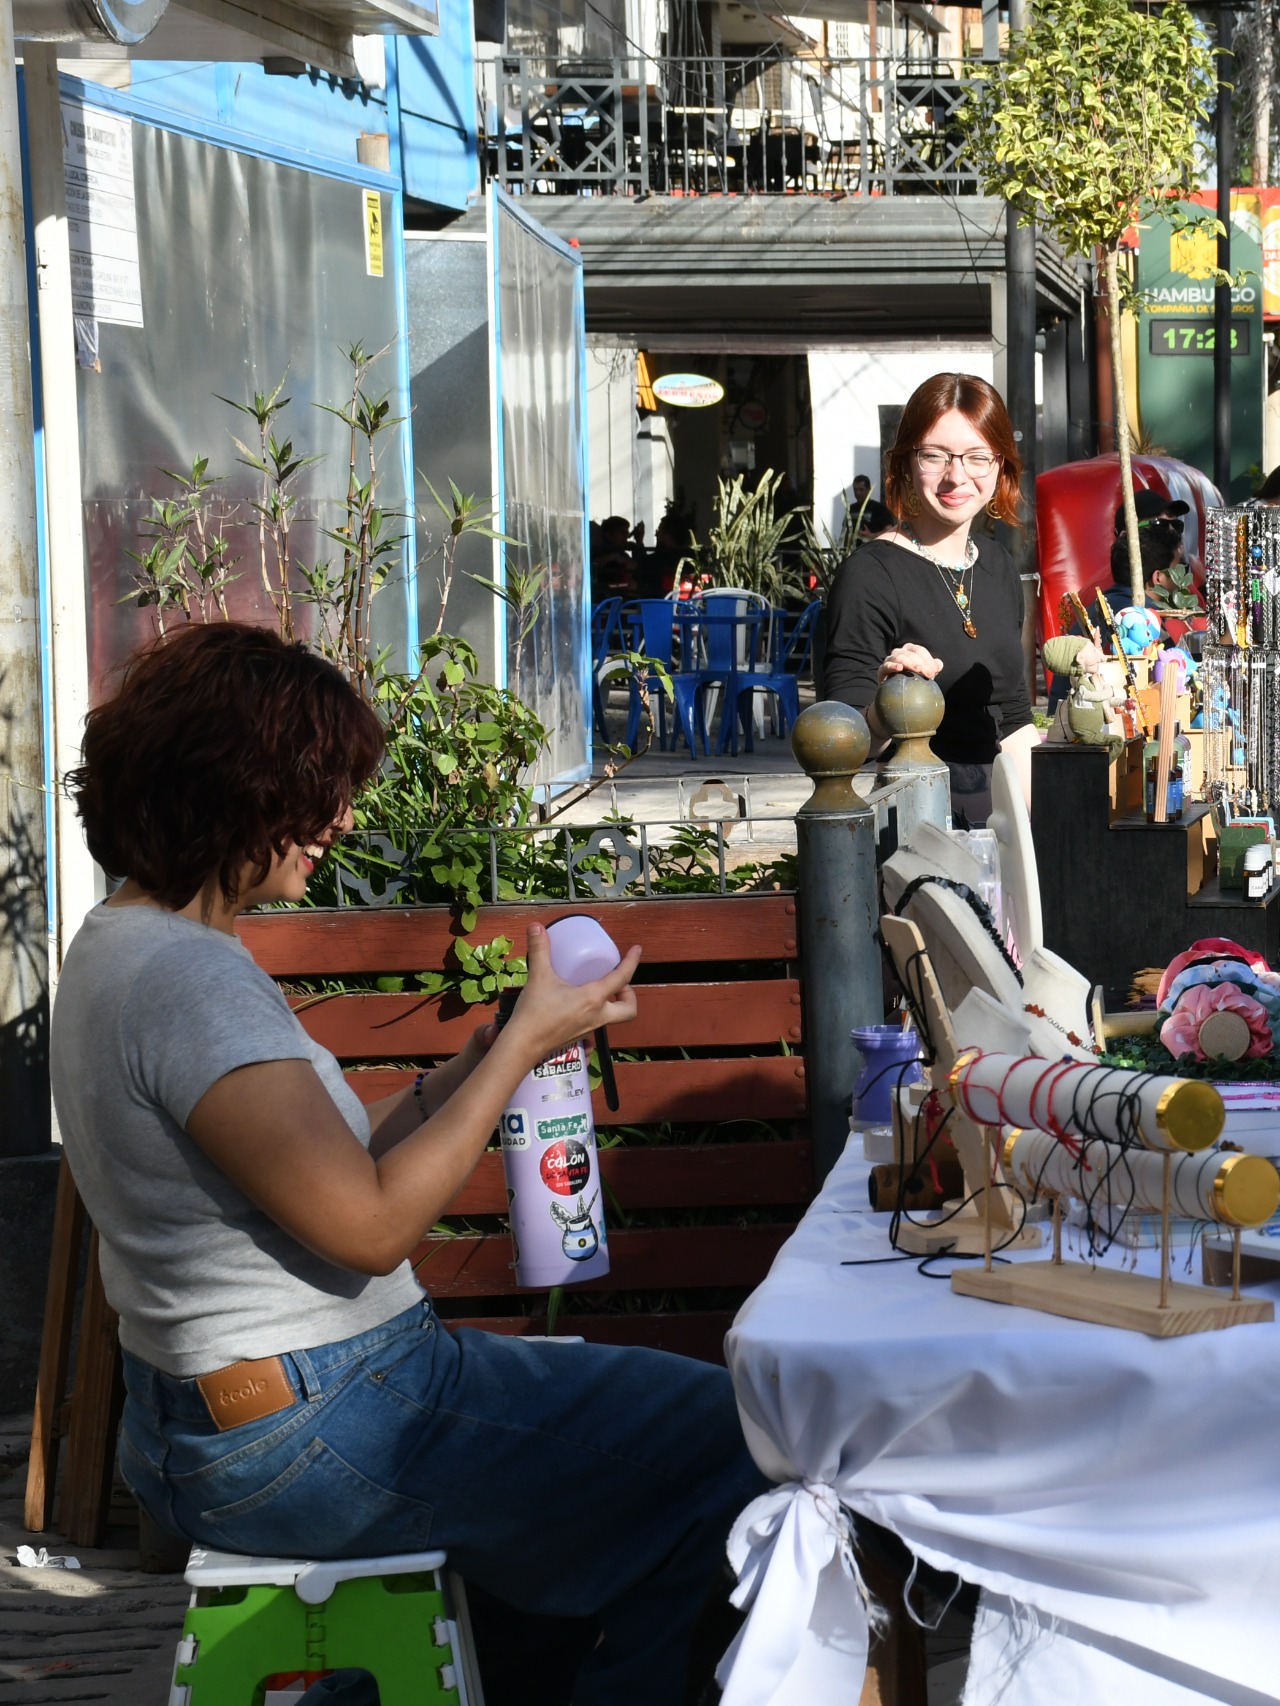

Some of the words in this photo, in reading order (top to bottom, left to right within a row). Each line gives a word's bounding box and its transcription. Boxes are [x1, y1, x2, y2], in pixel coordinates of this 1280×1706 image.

[1144, 287, 1256, 303] HAMBUGO
[536, 1061, 582, 1077] SABALERO
[541, 1122, 566, 1134] Santa
[568, 1121, 578, 1130] Fe
